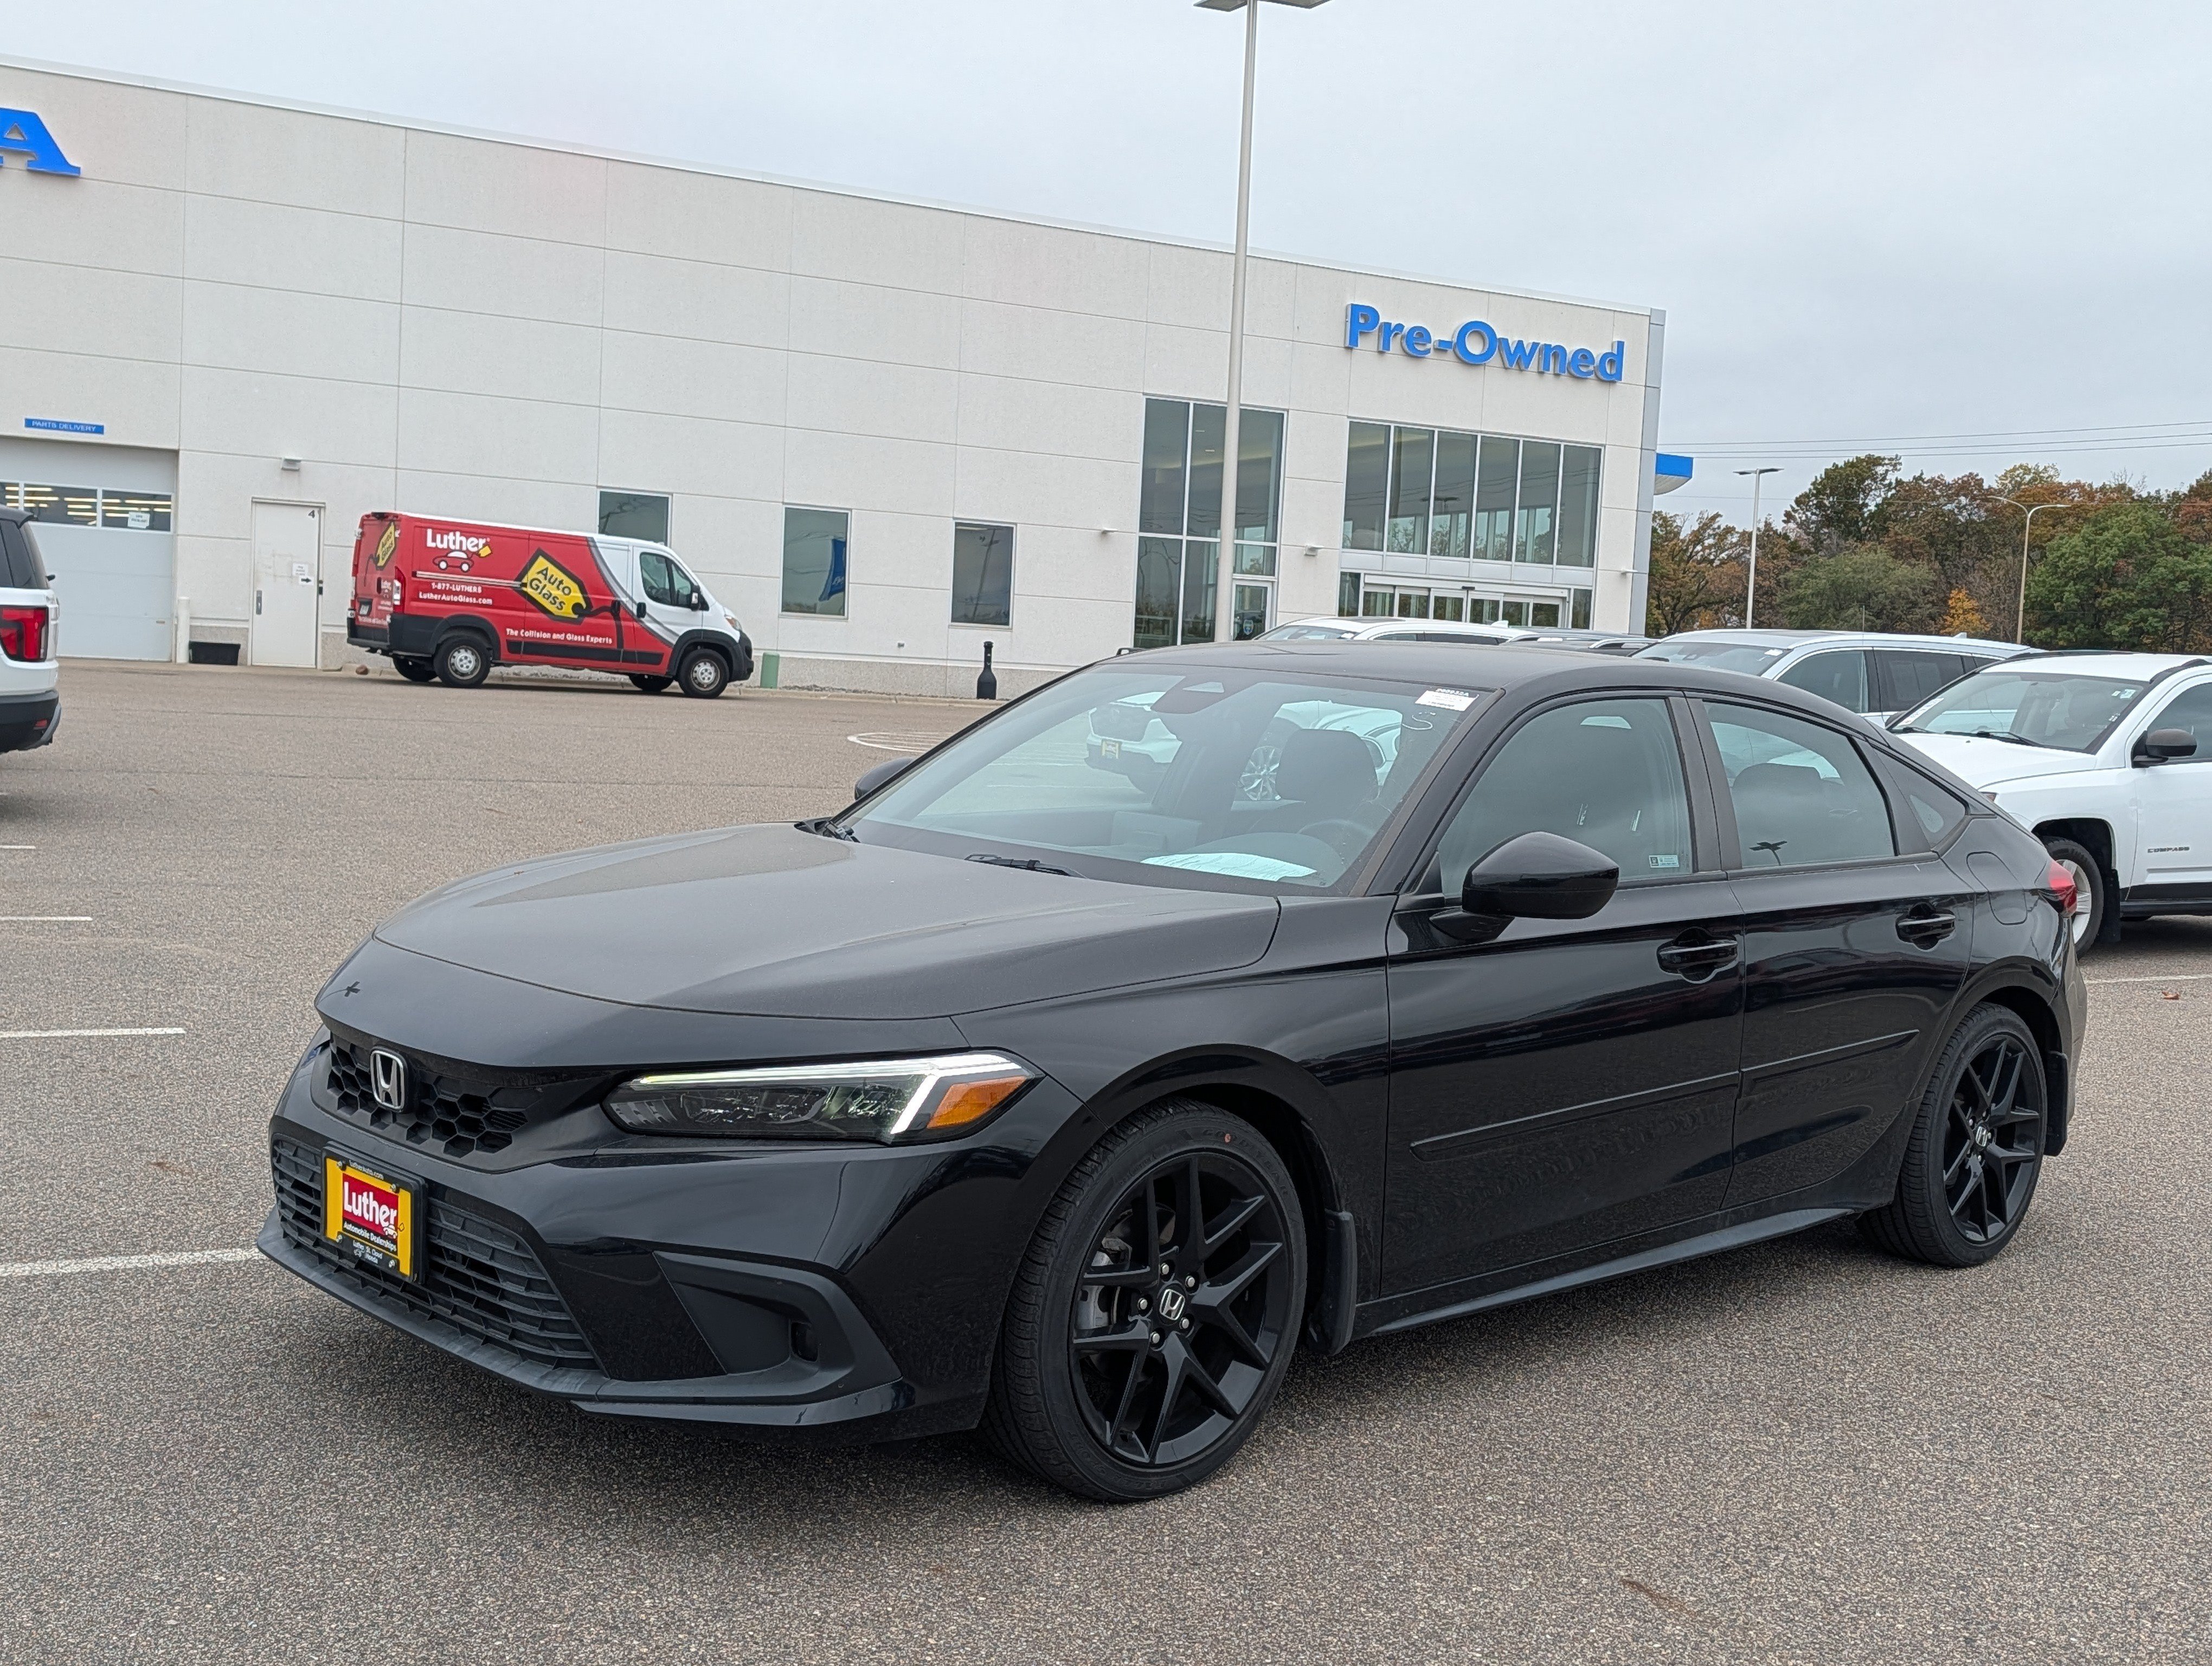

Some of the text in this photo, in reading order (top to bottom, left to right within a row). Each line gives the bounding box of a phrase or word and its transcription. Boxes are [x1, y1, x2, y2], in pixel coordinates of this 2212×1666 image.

[1344, 303, 1625, 382] Pre-Owned
[31, 420, 97, 432] PARTS DELIVERY
[308, 509, 315, 518] 4
[426, 528, 486, 552] Luther
[529, 577, 566, 611] Glass
[536, 567, 572, 596] Auto
[419, 591, 493, 605] LutherAutoGlass.com
[505, 628, 613, 645] The Collision and Glass Experts
[344, 1181, 397, 1228] Luther
[343, 1221, 397, 1252] Automobile Dealerships
